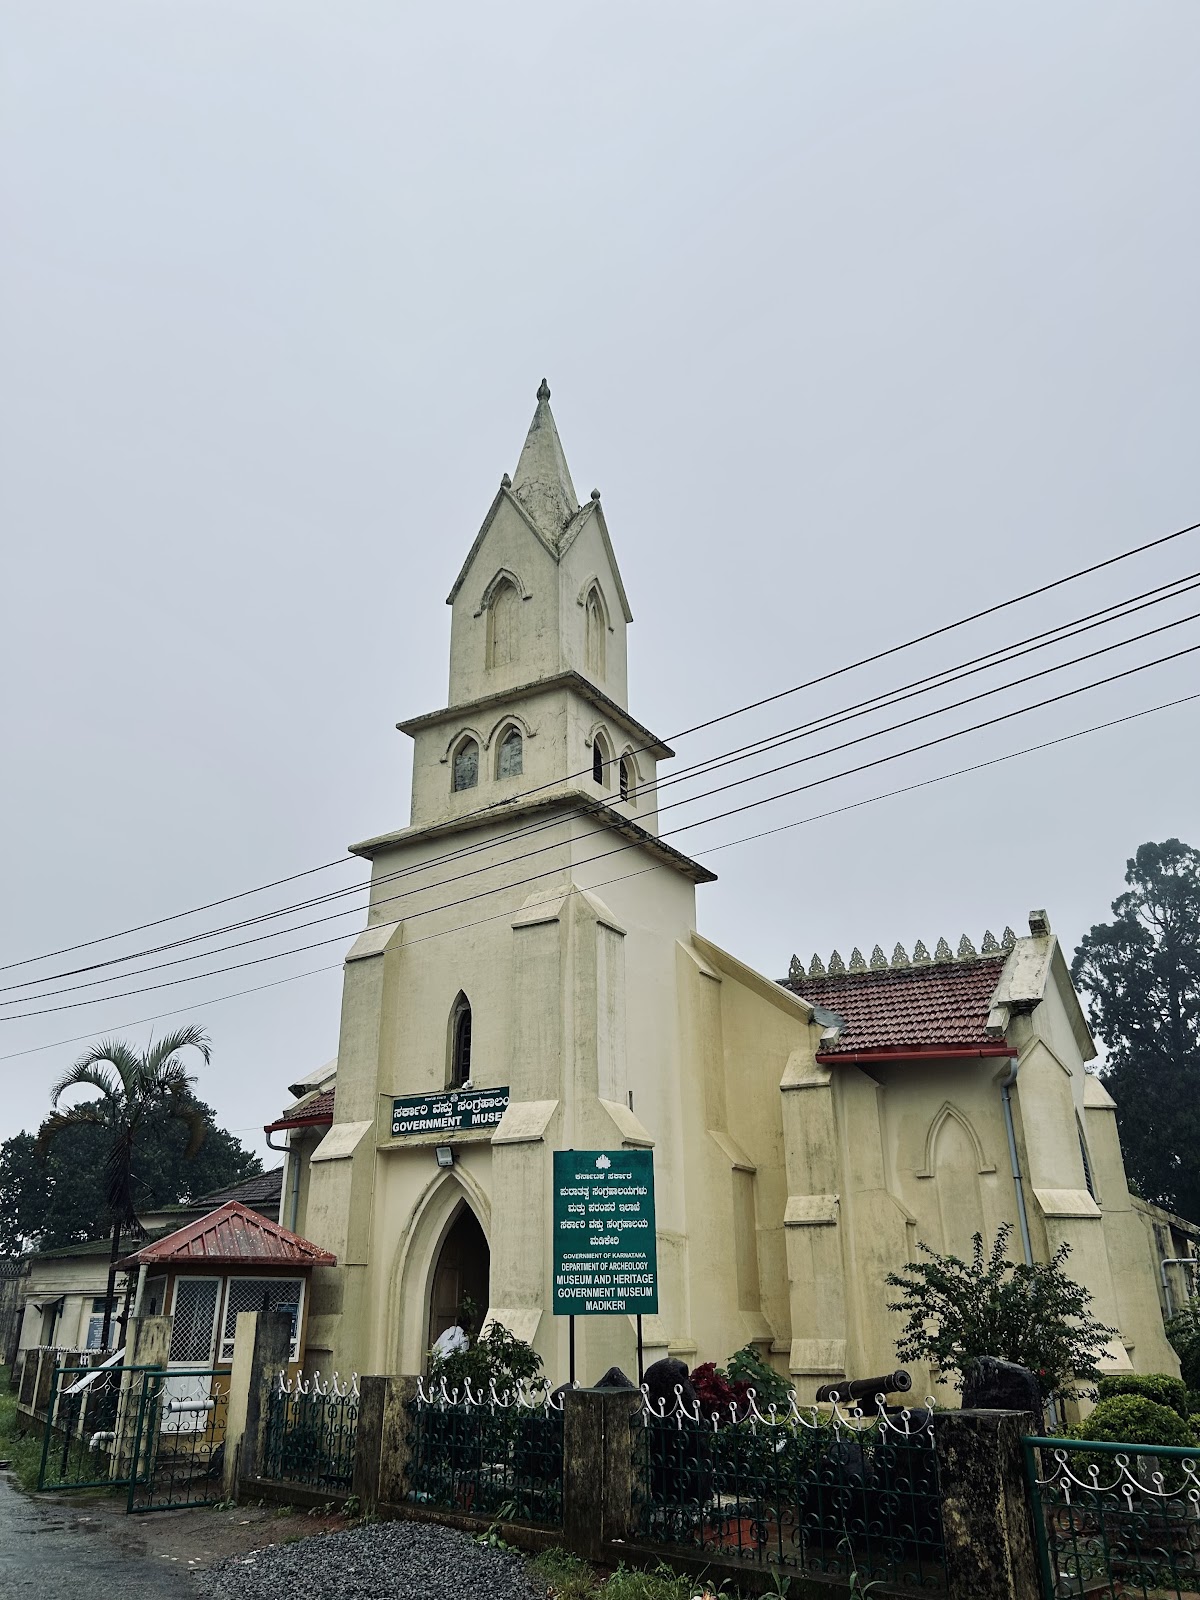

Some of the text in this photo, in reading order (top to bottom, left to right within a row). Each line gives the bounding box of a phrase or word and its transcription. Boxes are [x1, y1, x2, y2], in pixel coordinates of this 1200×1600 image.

[394, 1105, 428, 1118] ಸರ್ಕಾರಿ
[432, 1101, 453, 1116] ವಸ್ತು
[393, 1112, 502, 1132] GOVERNMENT MUSE
[608, 1172, 632, 1180] ಸರ್ಕಾರ
[568, 1202, 586, 1215] ಮತ್ತು
[589, 1202, 616, 1212] ಪರಂಪರೆ
[560, 1218, 648, 1231] ಸರ್ಕಾರಿ ವಸ್ತು ಸಂಗ್ರಹಾಲಯ
[589, 1235, 619, 1245] ಮಡಿಕೇರಿ
[562, 1261, 648, 1271] DEPARTMENT OF ARCHEOLOGY
[557, 1273, 654, 1285] MUSEUM AND HERITAGE
[558, 1287, 653, 1298] GOVERNMENT MUSEUM
[586, 1300, 626, 1310] MADIKERI
